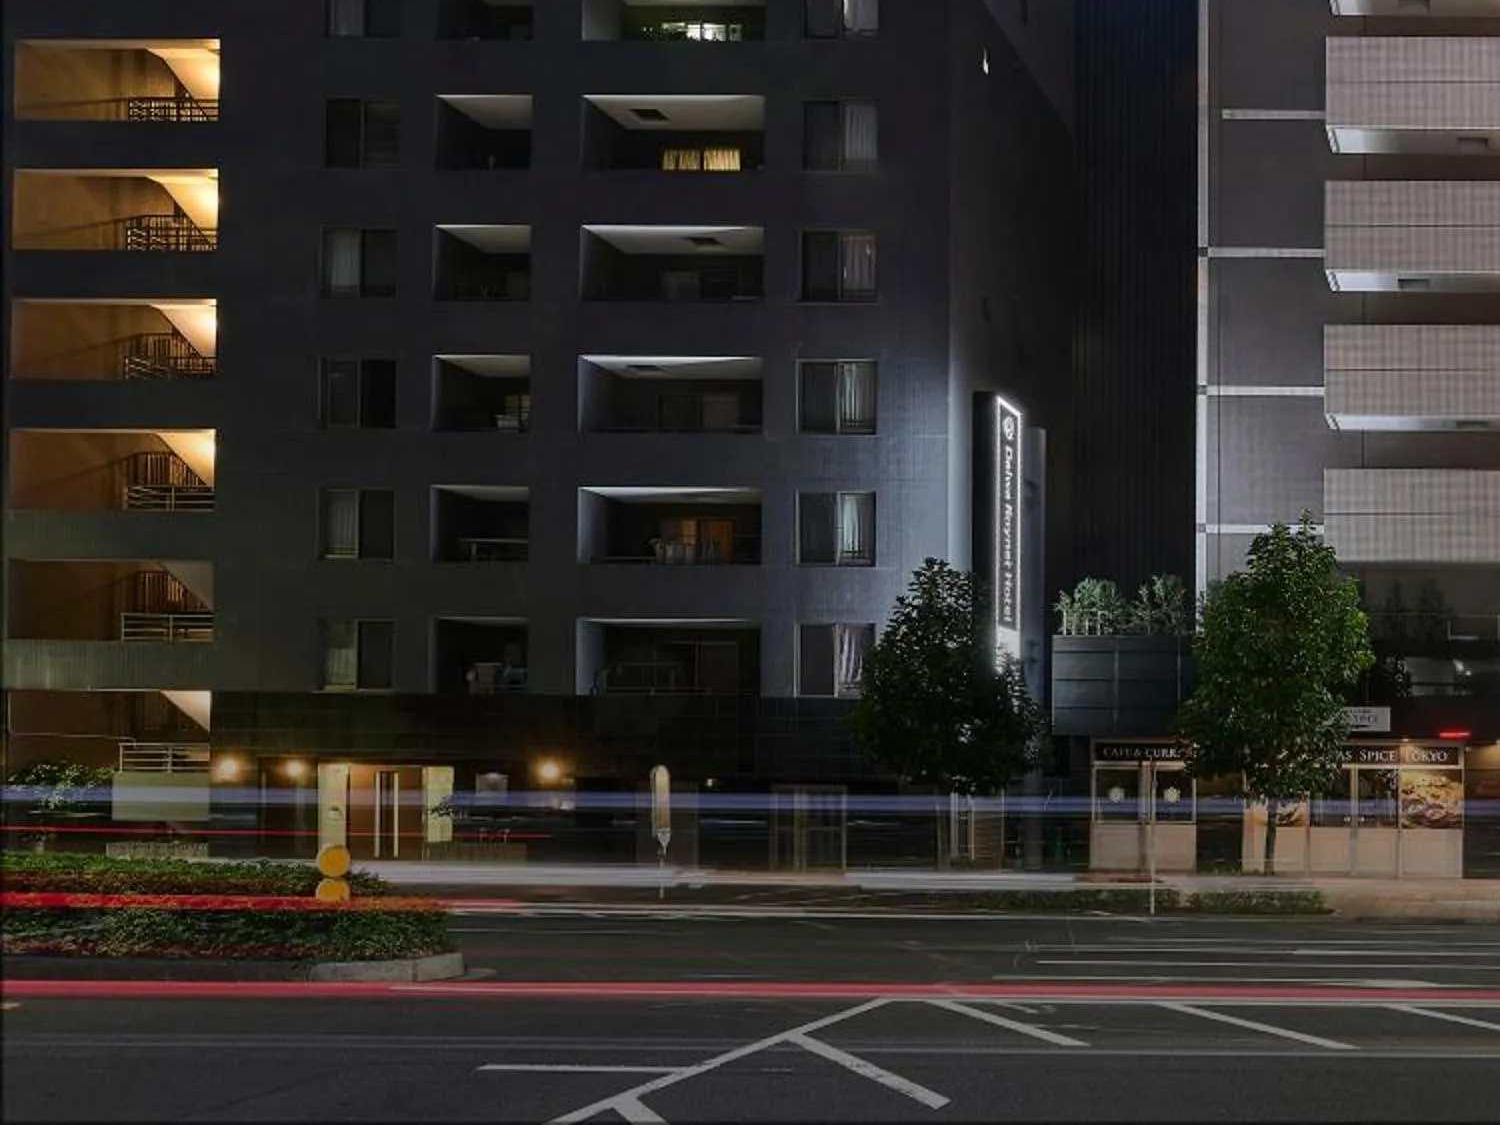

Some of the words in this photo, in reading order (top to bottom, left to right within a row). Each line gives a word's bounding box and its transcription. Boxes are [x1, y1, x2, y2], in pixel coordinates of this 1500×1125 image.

[1003, 446, 1014, 500] Daiwa
[1003, 572, 1013, 623] Hotel
[1145, 747, 1186, 758] CURR
[1359, 748, 1397, 762] SPICE
[1405, 749, 1449, 762] TOKYO
